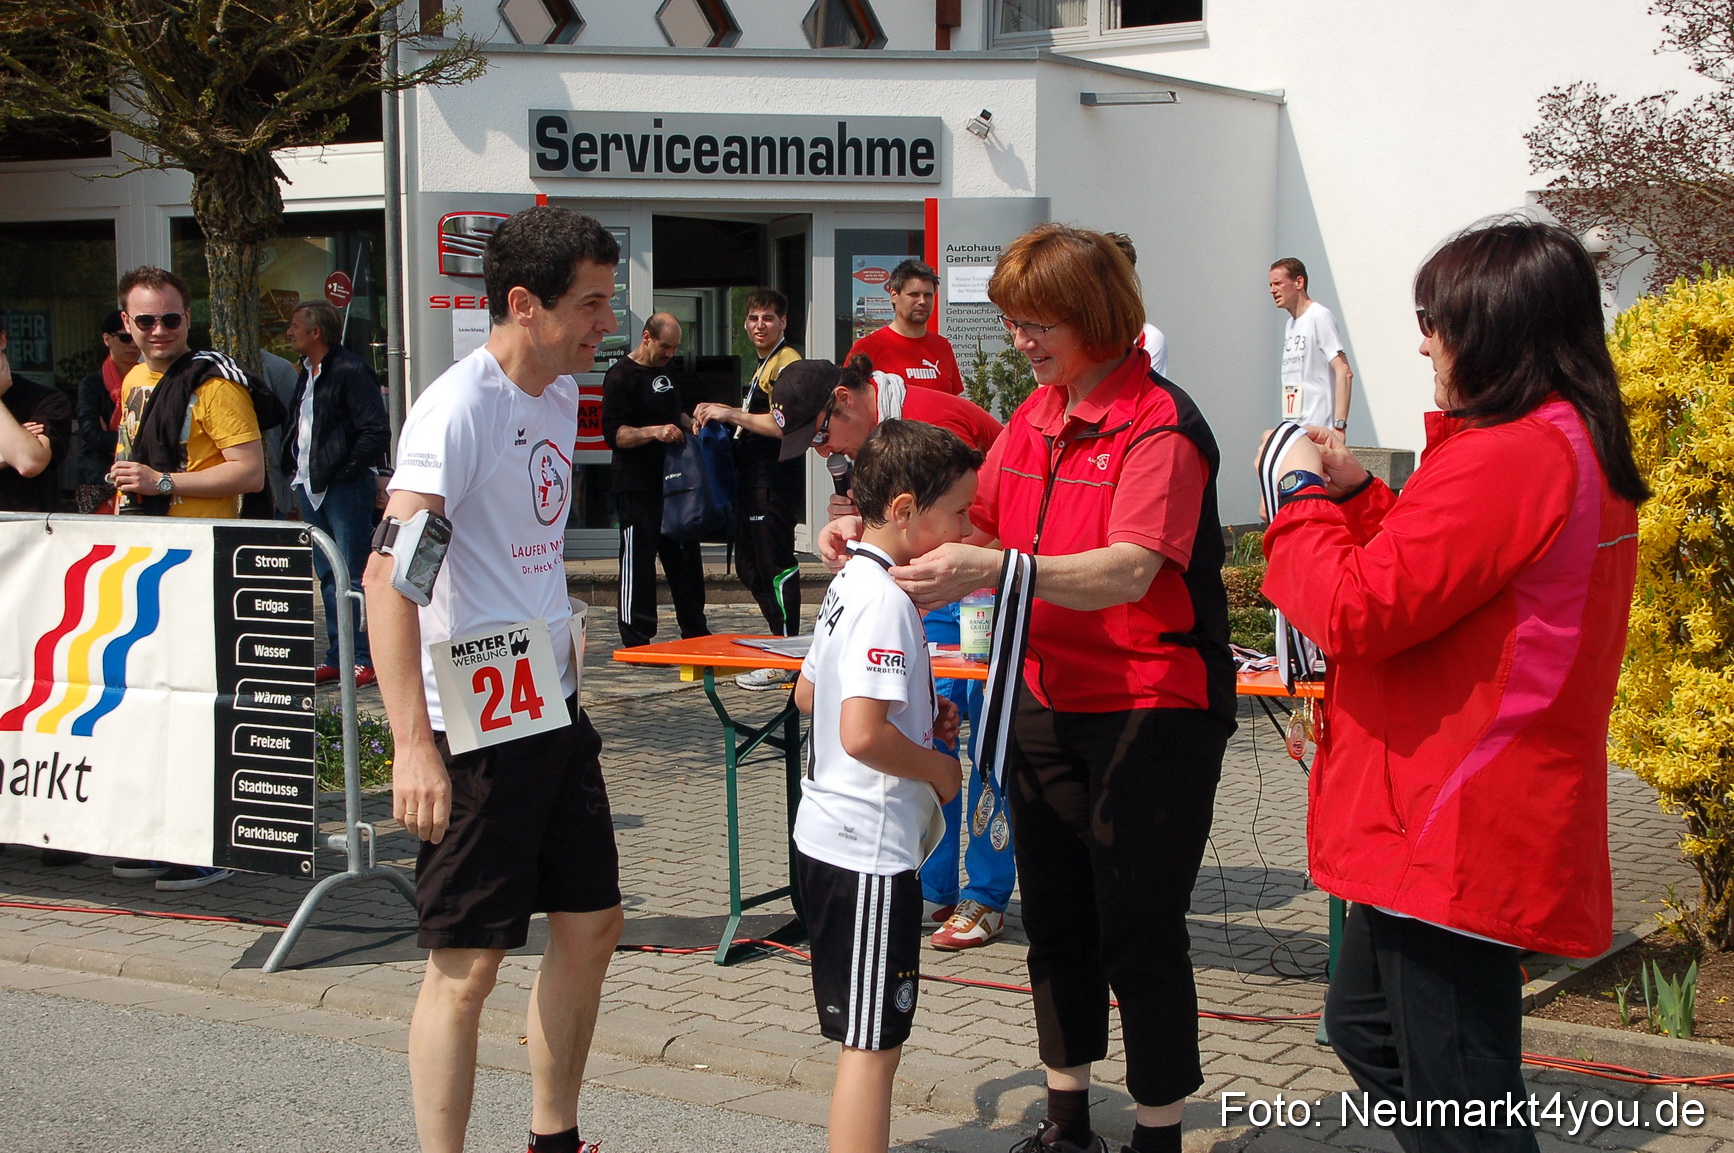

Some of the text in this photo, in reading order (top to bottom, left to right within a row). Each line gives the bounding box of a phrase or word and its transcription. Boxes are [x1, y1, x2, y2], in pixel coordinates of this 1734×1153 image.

[535, 115, 935, 177] Serviceannahme
[946, 244, 1001, 252] Autohaus
[946, 255, 992, 263] Gerhart
[2, 314, 46, 337] EHR
[905, 368, 937, 379] PUMA
[1287, 394, 1295, 413] 17
[511, 543, 547, 558] LAUFEN
[255, 555, 289, 568] Strom
[522, 561, 553, 575] Dr. Heck
[254, 599, 289, 613] Erdgas
[254, 644, 290, 658] Wasser
[451, 634, 506, 659] MEYER
[452, 647, 508, 667] WERBUNG
[254, 691, 292, 705] Wärme
[472, 657, 545, 732] 24
[250, 735, 291, 749] Freizeit
[0, 752, 92, 803] arkt
[238, 780, 298, 796] Stadtbusse
[237, 825, 299, 843] Parkhäuser
